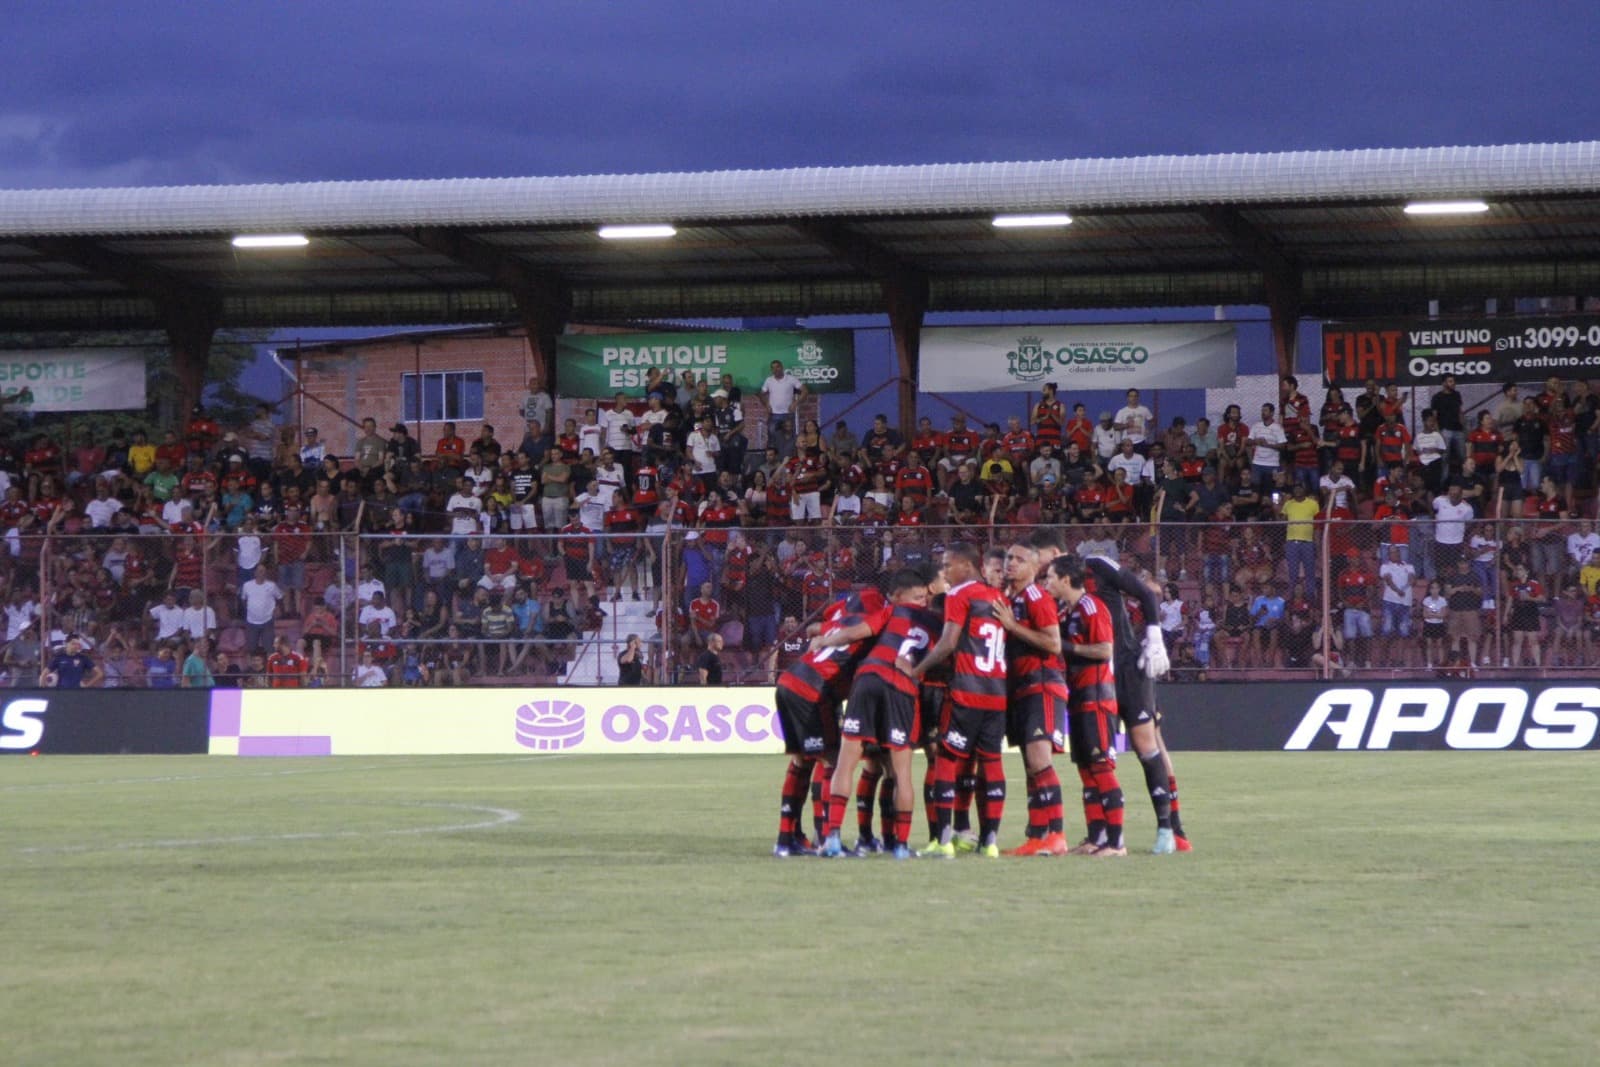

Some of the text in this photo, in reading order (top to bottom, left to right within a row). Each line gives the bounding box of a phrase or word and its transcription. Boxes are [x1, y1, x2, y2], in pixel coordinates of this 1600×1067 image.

[1409, 329, 1491, 345] VENTUNO
[1524, 325, 1600, 349] 3099-0
[602, 345, 727, 366] PRATIQUE
[1055, 346, 1149, 365] OSASCO
[1325, 331, 1402, 380] FIAT
[1513, 356, 1600, 368] ventuno.co
[1408, 357, 1491, 377] Osasco
[0, 699, 48, 750] S
[1283, 687, 1600, 749] APOS
